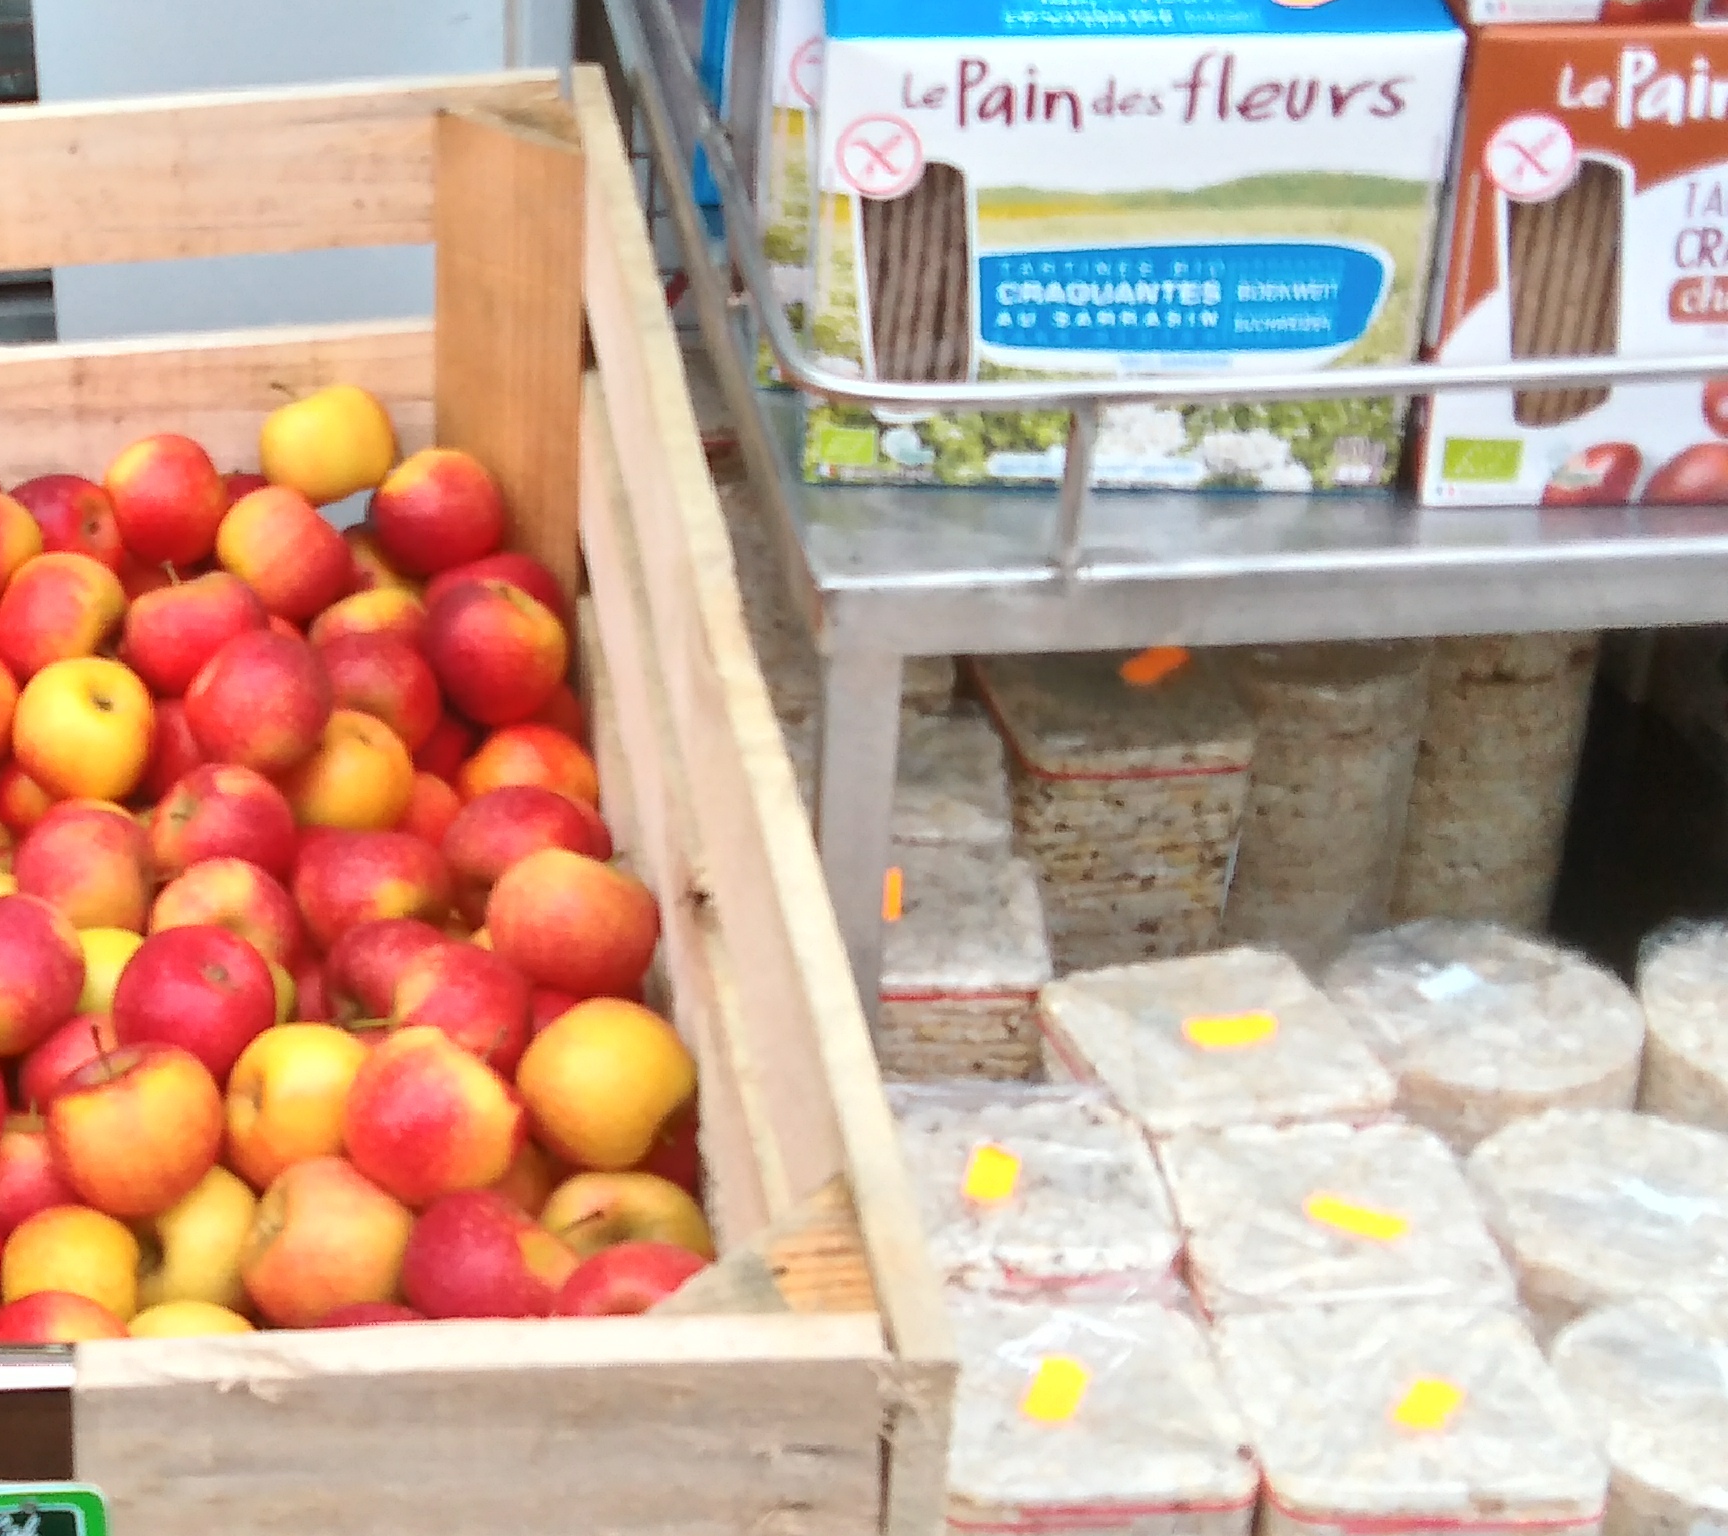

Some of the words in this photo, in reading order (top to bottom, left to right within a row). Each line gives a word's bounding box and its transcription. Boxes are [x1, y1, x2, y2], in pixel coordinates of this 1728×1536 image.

[901, 72, 947, 110] Le
[956, 55, 1085, 132] Pain
[1091, 75, 1164, 117] des
[1173, 44, 1414, 124] fleurs
[1557, 63, 1613, 109] Le
[995, 278, 1222, 308] CRAQUANTES
